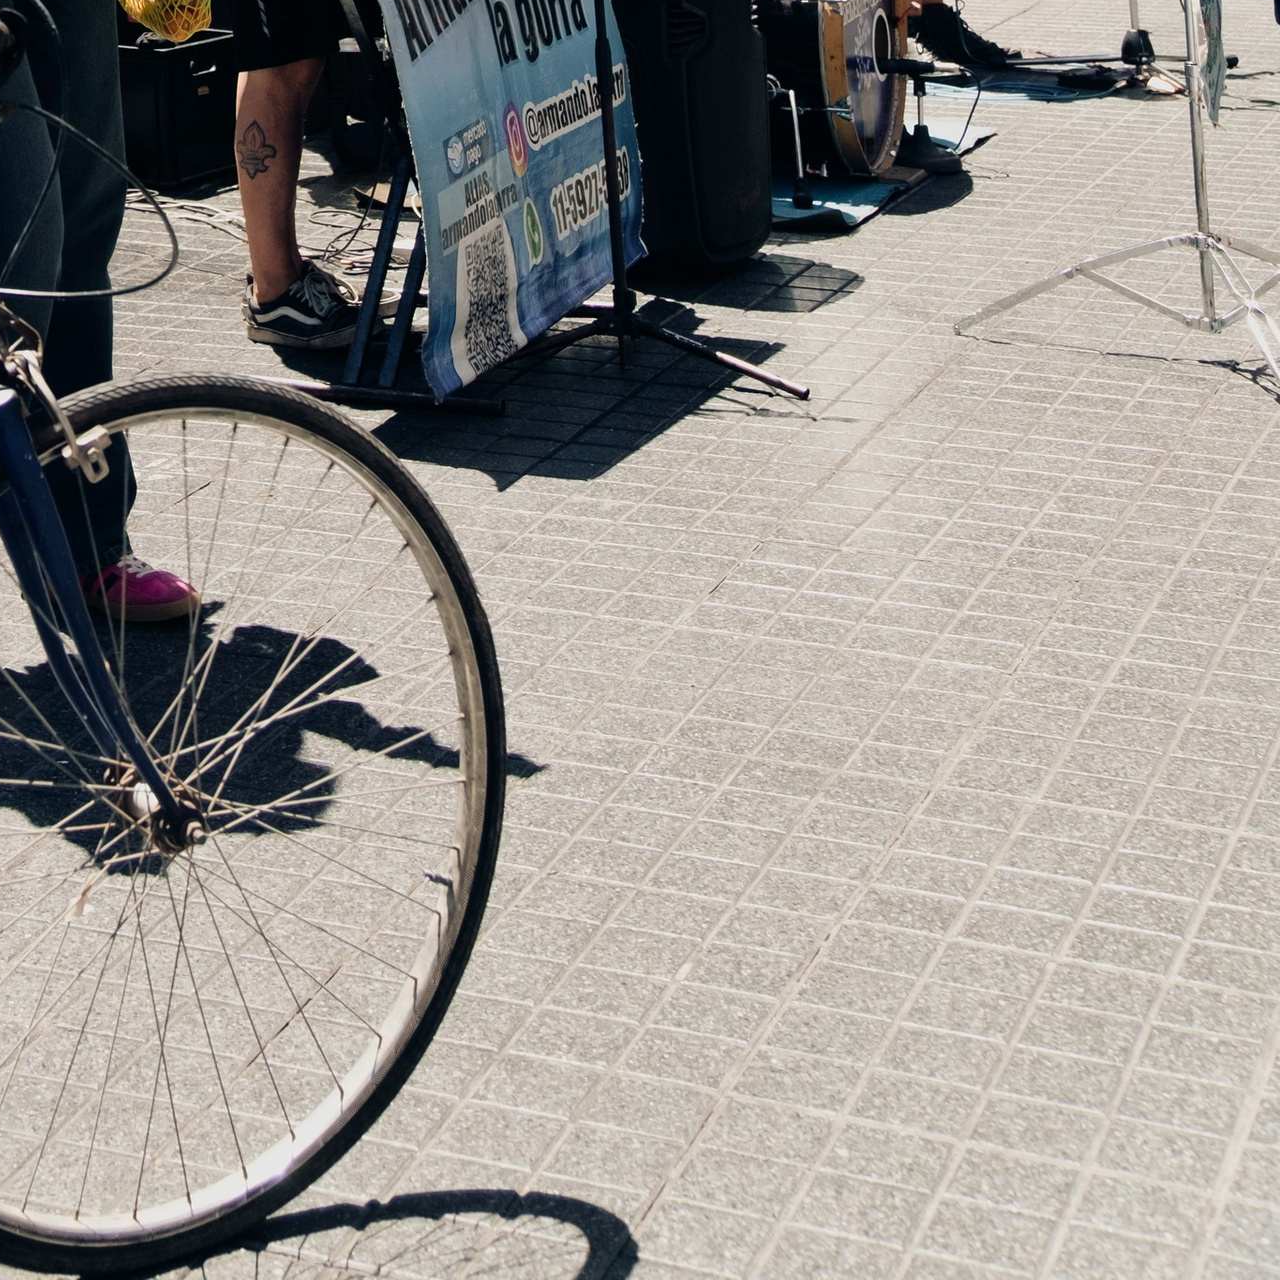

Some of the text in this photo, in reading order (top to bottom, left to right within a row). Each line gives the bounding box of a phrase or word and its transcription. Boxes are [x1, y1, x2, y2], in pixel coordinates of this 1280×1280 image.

[462, 120, 488, 146] mercado
[465, 144, 482, 169] pago
[552, 151, 630, 234] 11-5927-538
